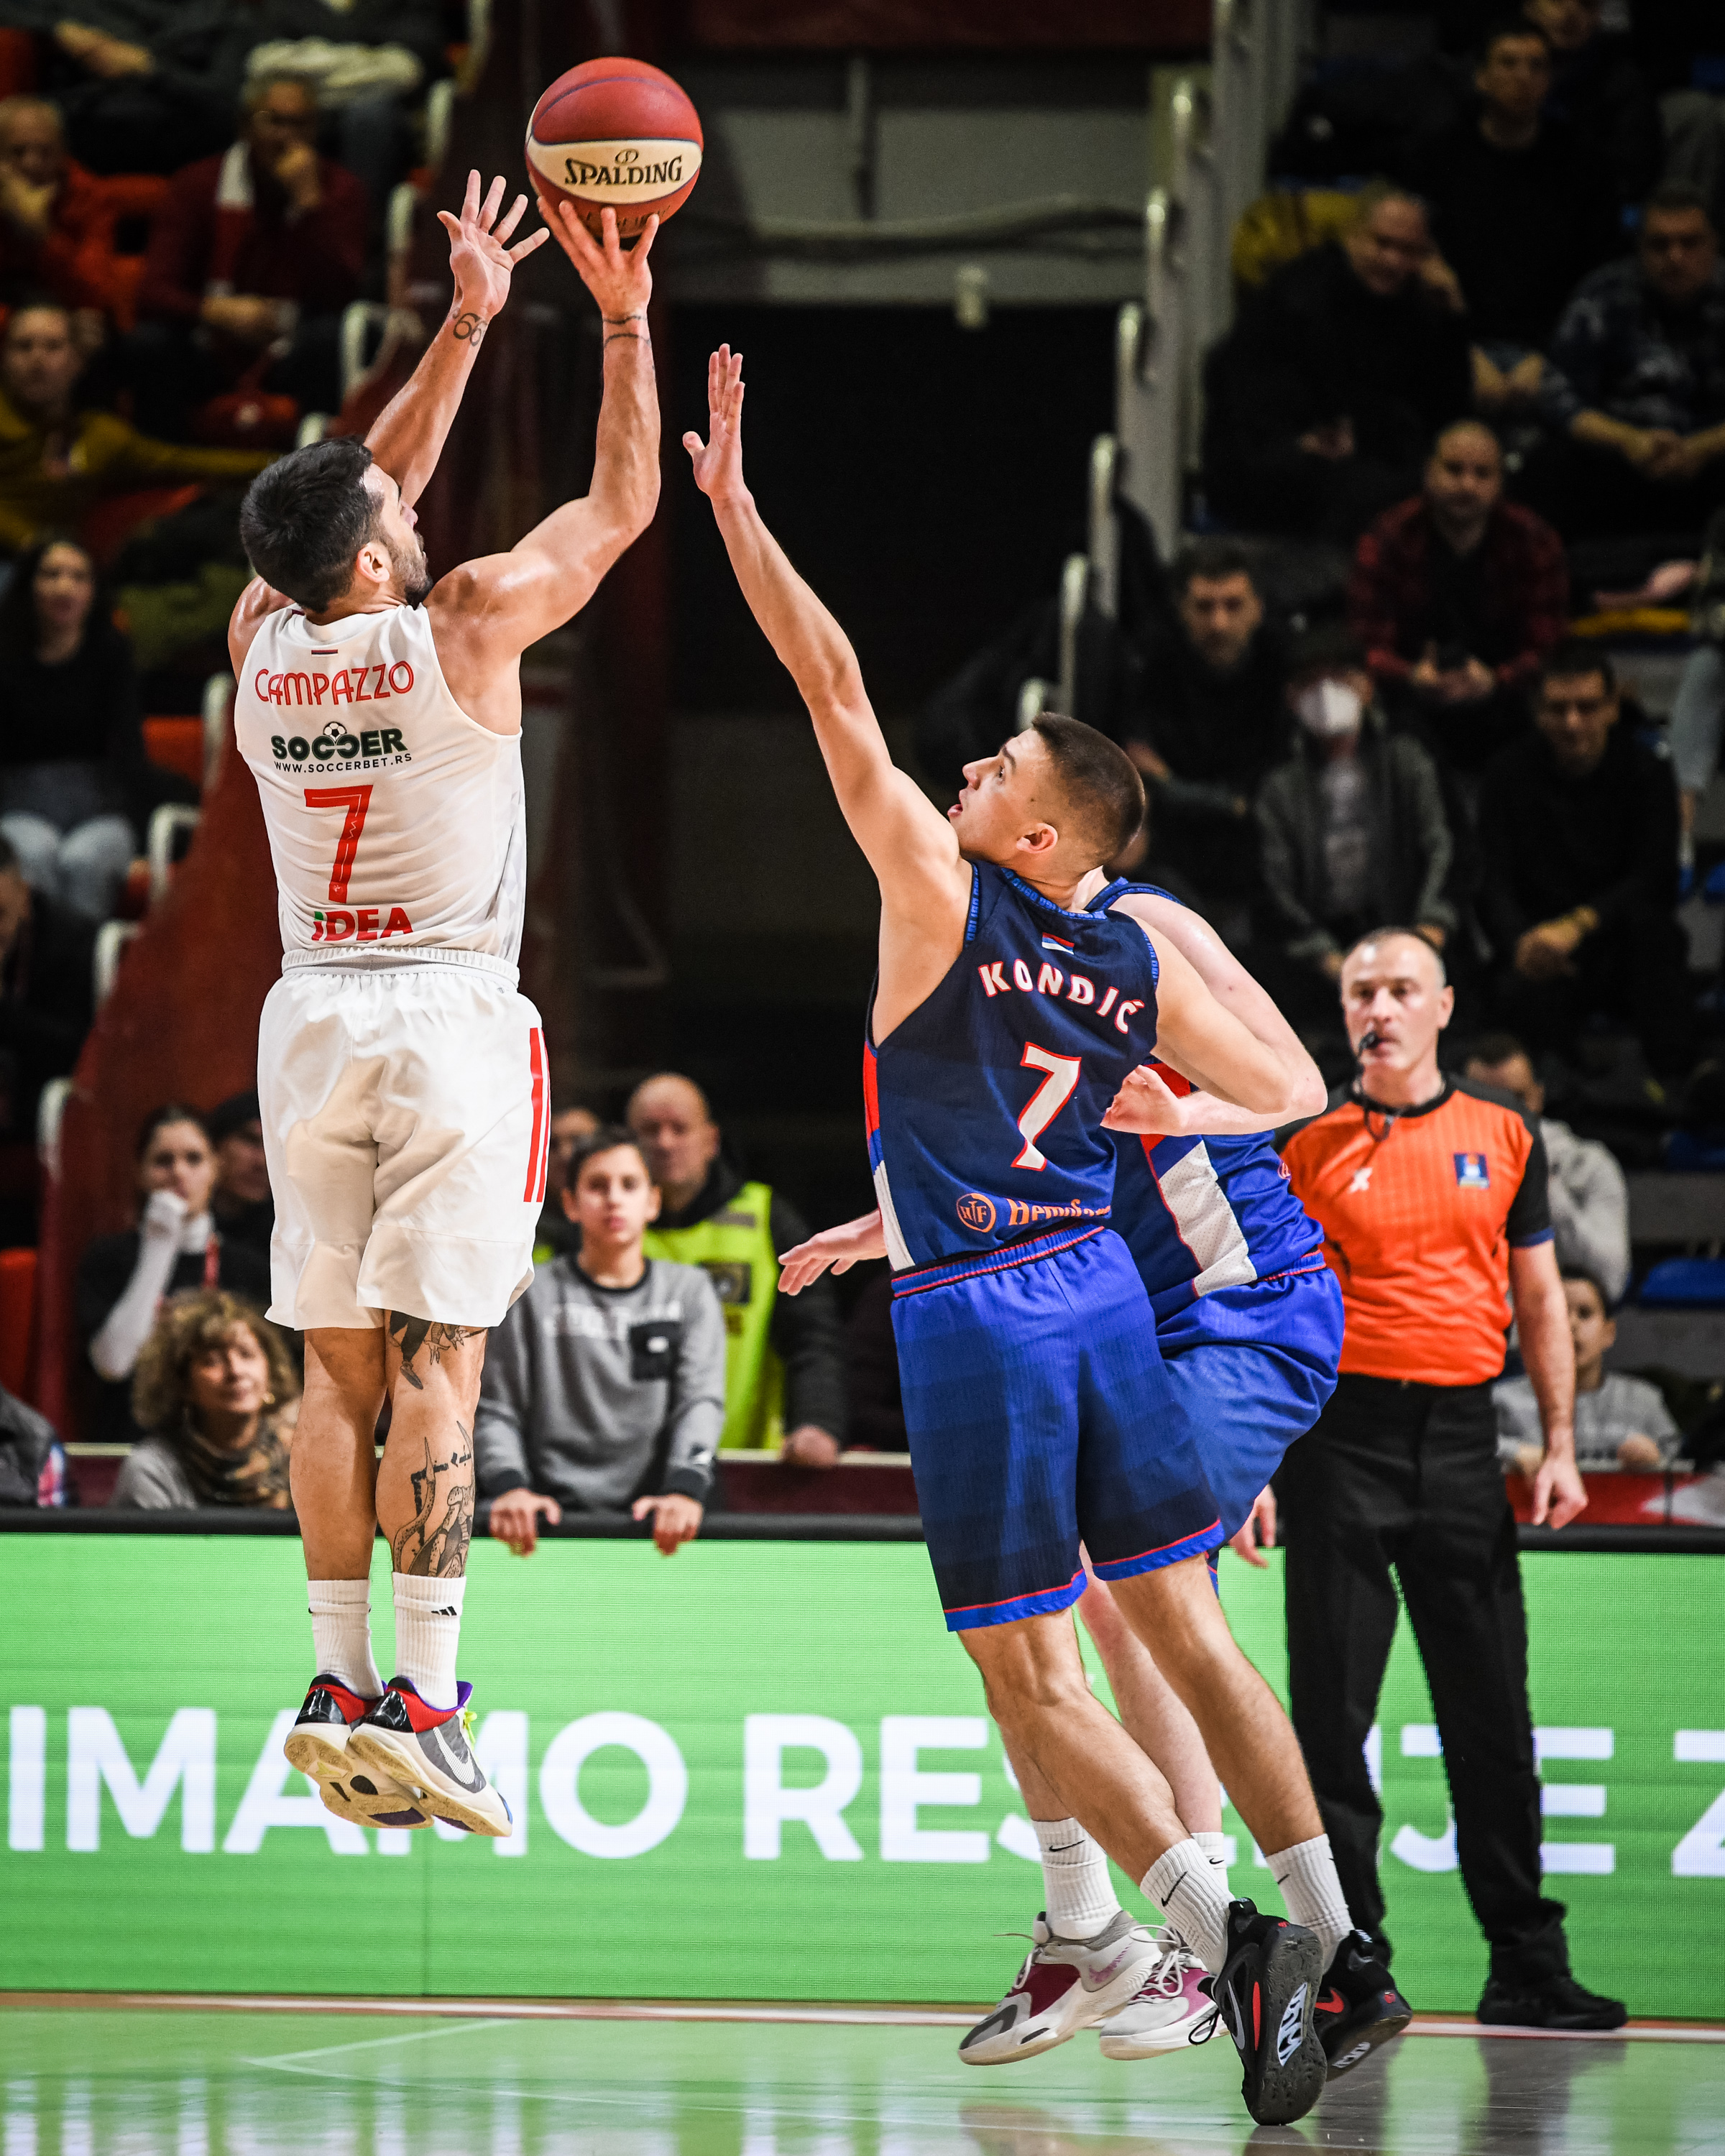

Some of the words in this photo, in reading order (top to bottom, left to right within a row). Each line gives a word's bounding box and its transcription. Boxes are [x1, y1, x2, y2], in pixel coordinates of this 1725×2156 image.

[565, 154, 684, 186] SPALDING
[254, 660, 415, 706] CAMPAZZO
[270, 727, 409, 762] SOCCER
[273, 752, 413, 773] WWW.SOCCERBET.RS
[303, 783, 374, 904] 7
[978, 958, 1146, 1034] KONDIĆ
[1010, 1041, 1082, 1172] 7
